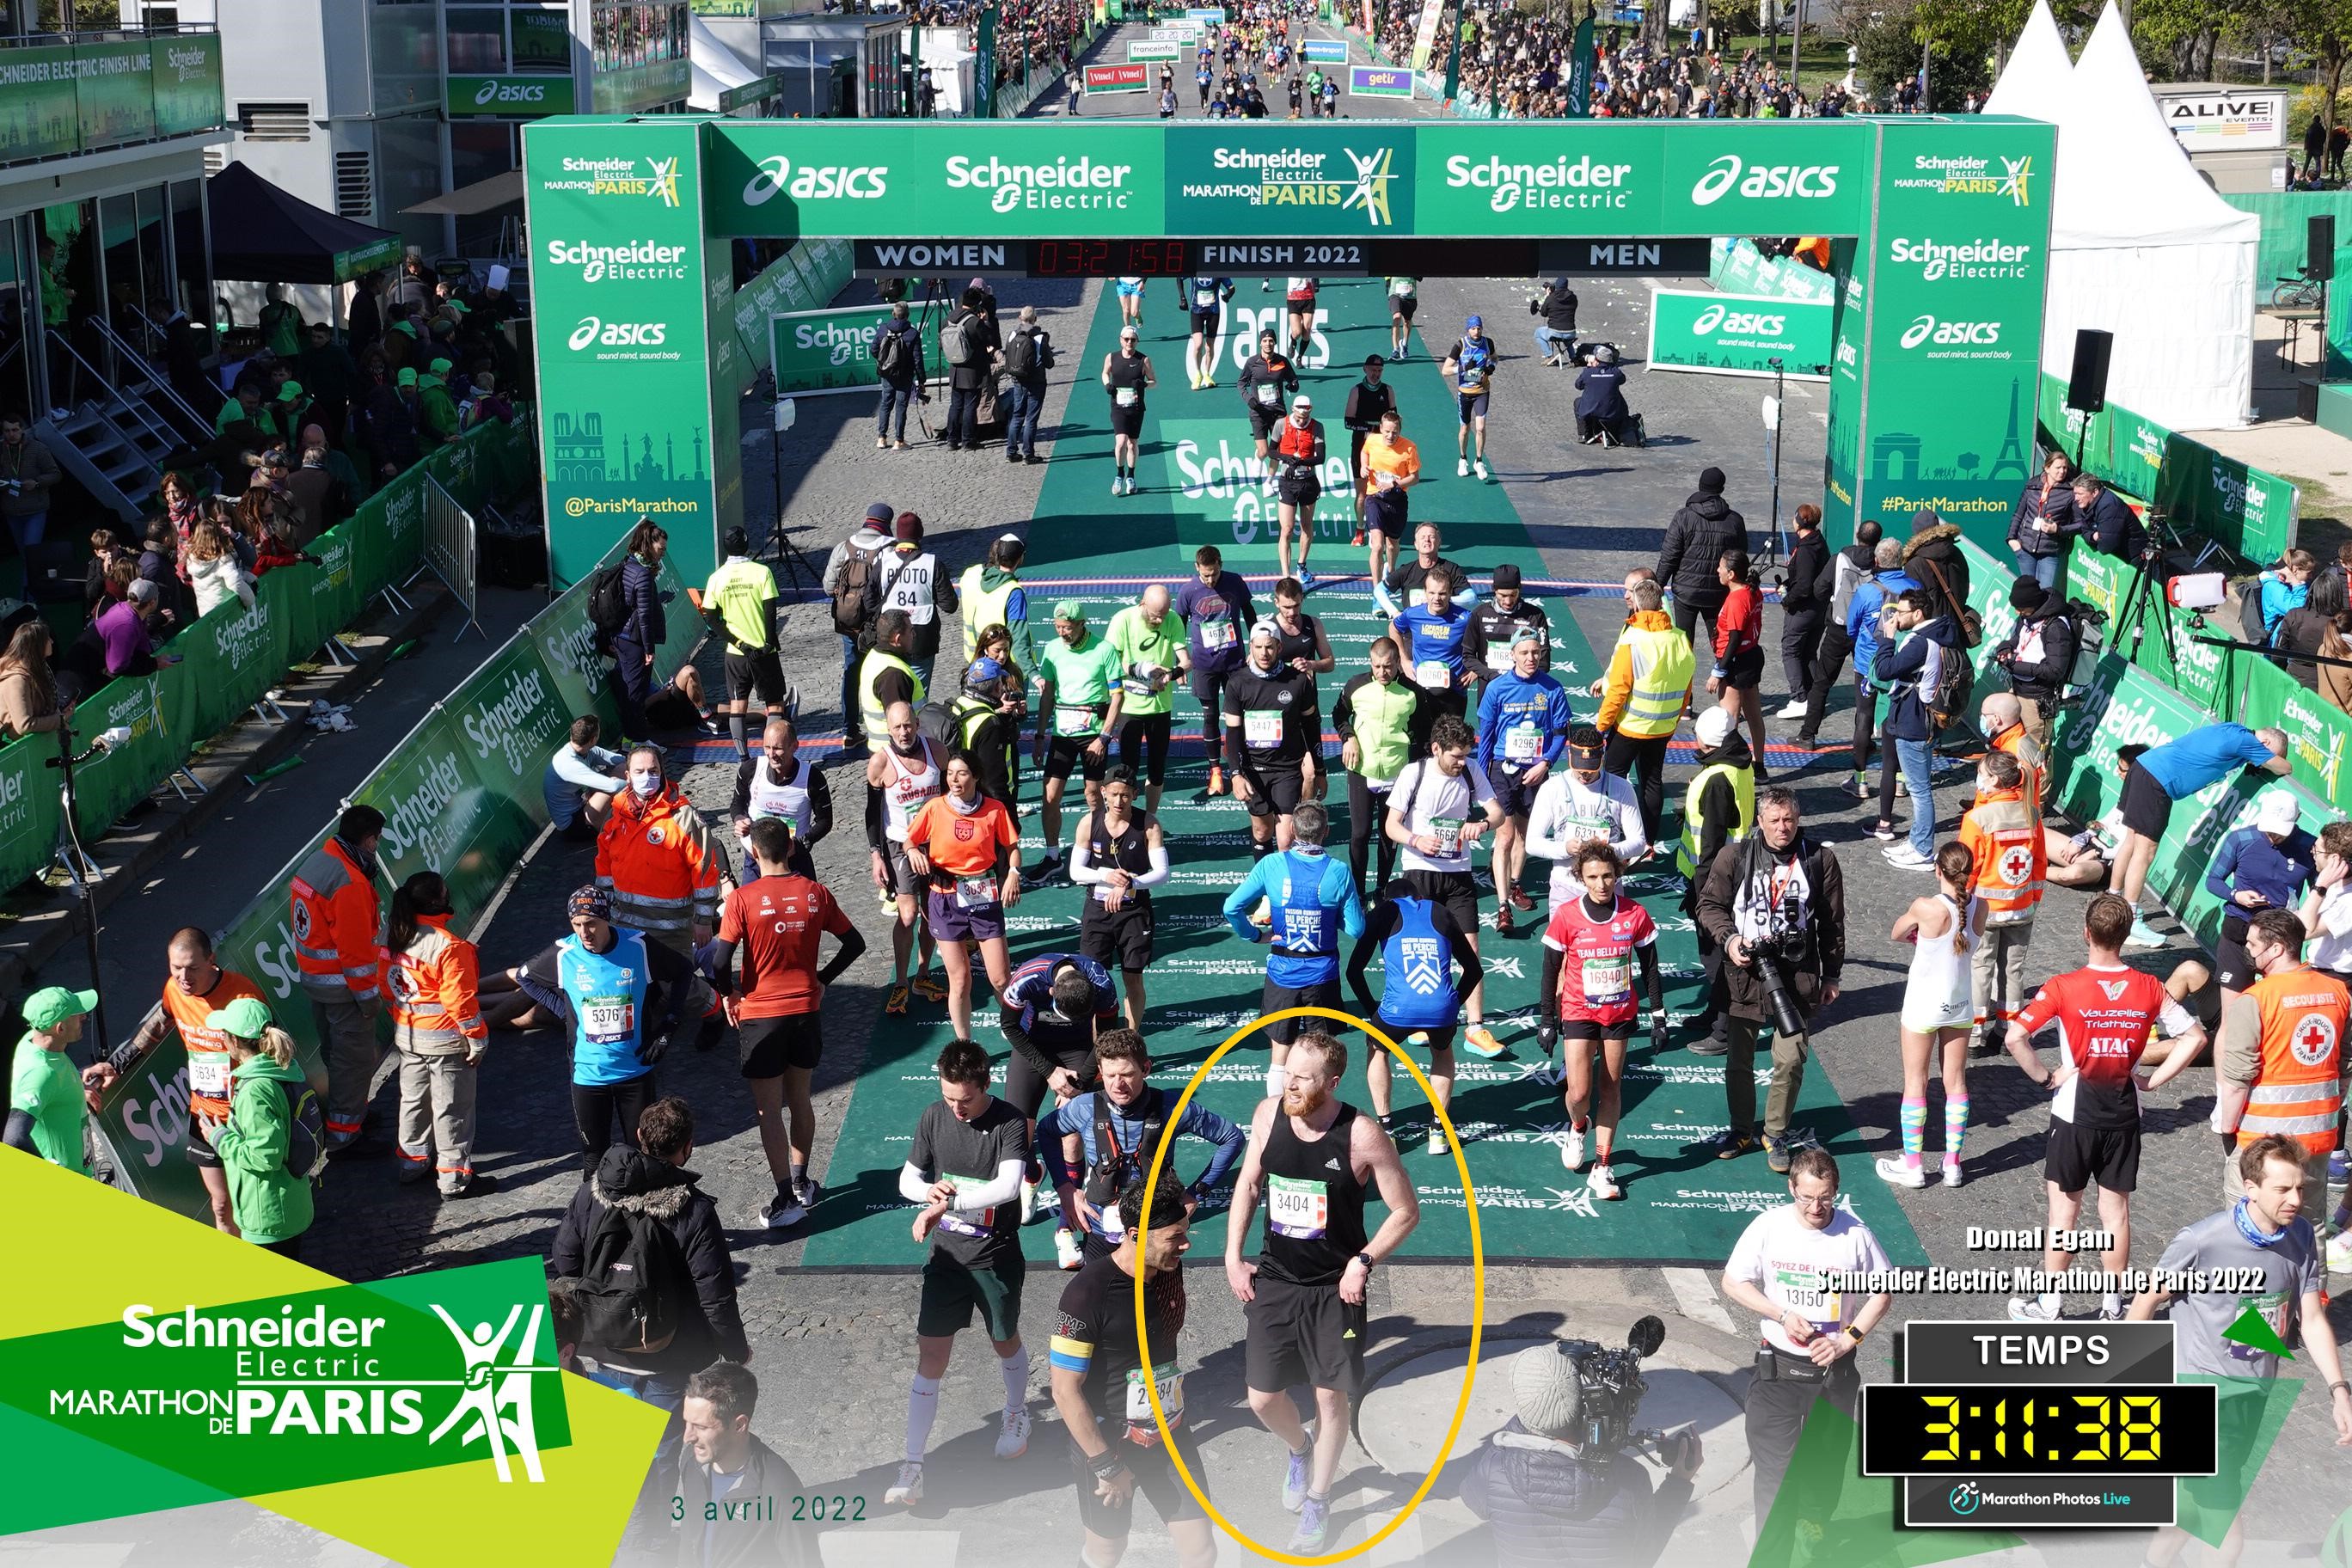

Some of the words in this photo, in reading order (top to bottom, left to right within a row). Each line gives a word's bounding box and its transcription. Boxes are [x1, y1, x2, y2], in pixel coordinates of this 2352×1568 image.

[168, 46, 205, 68] Schneider
[1133, 44, 1173, 53] franceinfo
[52, 58, 97, 80] ELECTRIC
[100, 56, 129, 76] FINISH
[131, 53, 151, 72] LINE
[1369, 72, 1396, 85] getir
[562, 157, 635, 172] Schneider
[1214, 148, 1326, 169] Schneider
[1915, 156, 1989, 169] Schneider
[946, 156, 1131, 189] Schneider
[1261, 168, 1324, 181] Electric
[1447, 155, 1632, 188] Schneider
[544, 181, 595, 190] MARATHON
[595, 181, 646, 194] PARIS
[790, 166, 888, 199] asics
[1740, 166, 1840, 199] asics
[1894, 179, 1945, 188] MARATHON
[1945, 179, 1998, 193] PARIS
[1183, 184, 1262, 198] MARATHON
[1262, 184, 1342, 205] PARIS
[1250, 196, 1262, 205] DE
[548, 240, 686, 265] Schneider
[873, 245, 1005, 267] WOMEN
[1204, 246, 1294, 264] FINISH
[1303, 246, 1361, 264] 2022
[1589, 244, 1660, 266] MEN
[1891, 238, 2030, 263] Schneider
[600, 323, 666, 345] asics
[1722, 313, 1786, 336] asics
[1932, 322, 2001, 345] asics
[1717, 338, 1736, 347] sound
[1737, 340, 1755, 350] mind,
[1756, 340, 1777, 350] sound
[1778, 343, 1796, 352] body
[619, 352, 638, 361] mind,
[662, 352, 681, 361] body
[1950, 350, 1969, 360] mind,
[1993, 351, 2012, 360] body
[2212, 466, 2267, 508] Schneider
[565, 497, 698, 517] @ParisMarathon
[1882, 496, 2008, 513] #ParisMarathon
[2076, 548, 2105, 577] Schneider
[897, 591, 918, 607] 84
[2086, 580, 2106, 608] PARIS
[214, 601, 270, 657] Schneider
[546, 609, 597, 677] Schnei
[463, 668, 546, 759] Schneider
[130, 715, 150, 743] ARIS
[515, 705, 561, 759] Electric
[1512, 740, 1534, 749] 4296
[2299, 739, 2324, 772] PARIS
[381, 751, 463, 860] Schneider
[1285, 915, 1295, 924] DU
[1296, 915, 1322, 925] PERCHE
[1402, 943, 1412, 952] DU
[1412, 943, 1438, 952] PERCHE
[1577, 948, 1596, 959] TEAM
[1596, 946, 1618, 958] BELLA
[1589, 969, 1621, 984] 16940
[592, 1008, 619, 1022] 5376
[2079, 1008, 2147, 1020] Vauzelles
[2084, 1020, 2141, 1030] Triathlon
[2088, 1037, 2135, 1054] ATAC
[2294, 1040, 2331, 1063] FRANÇAISE
[1651, 1124, 1732, 1132] Schneid
[1277, 1193, 1309, 1212] 3404
[1676, 1190, 1785, 1200] Schneider
[1772, 1261, 1796, 1271] SOYEZ
[1786, 1289, 1823, 1307] 13150
